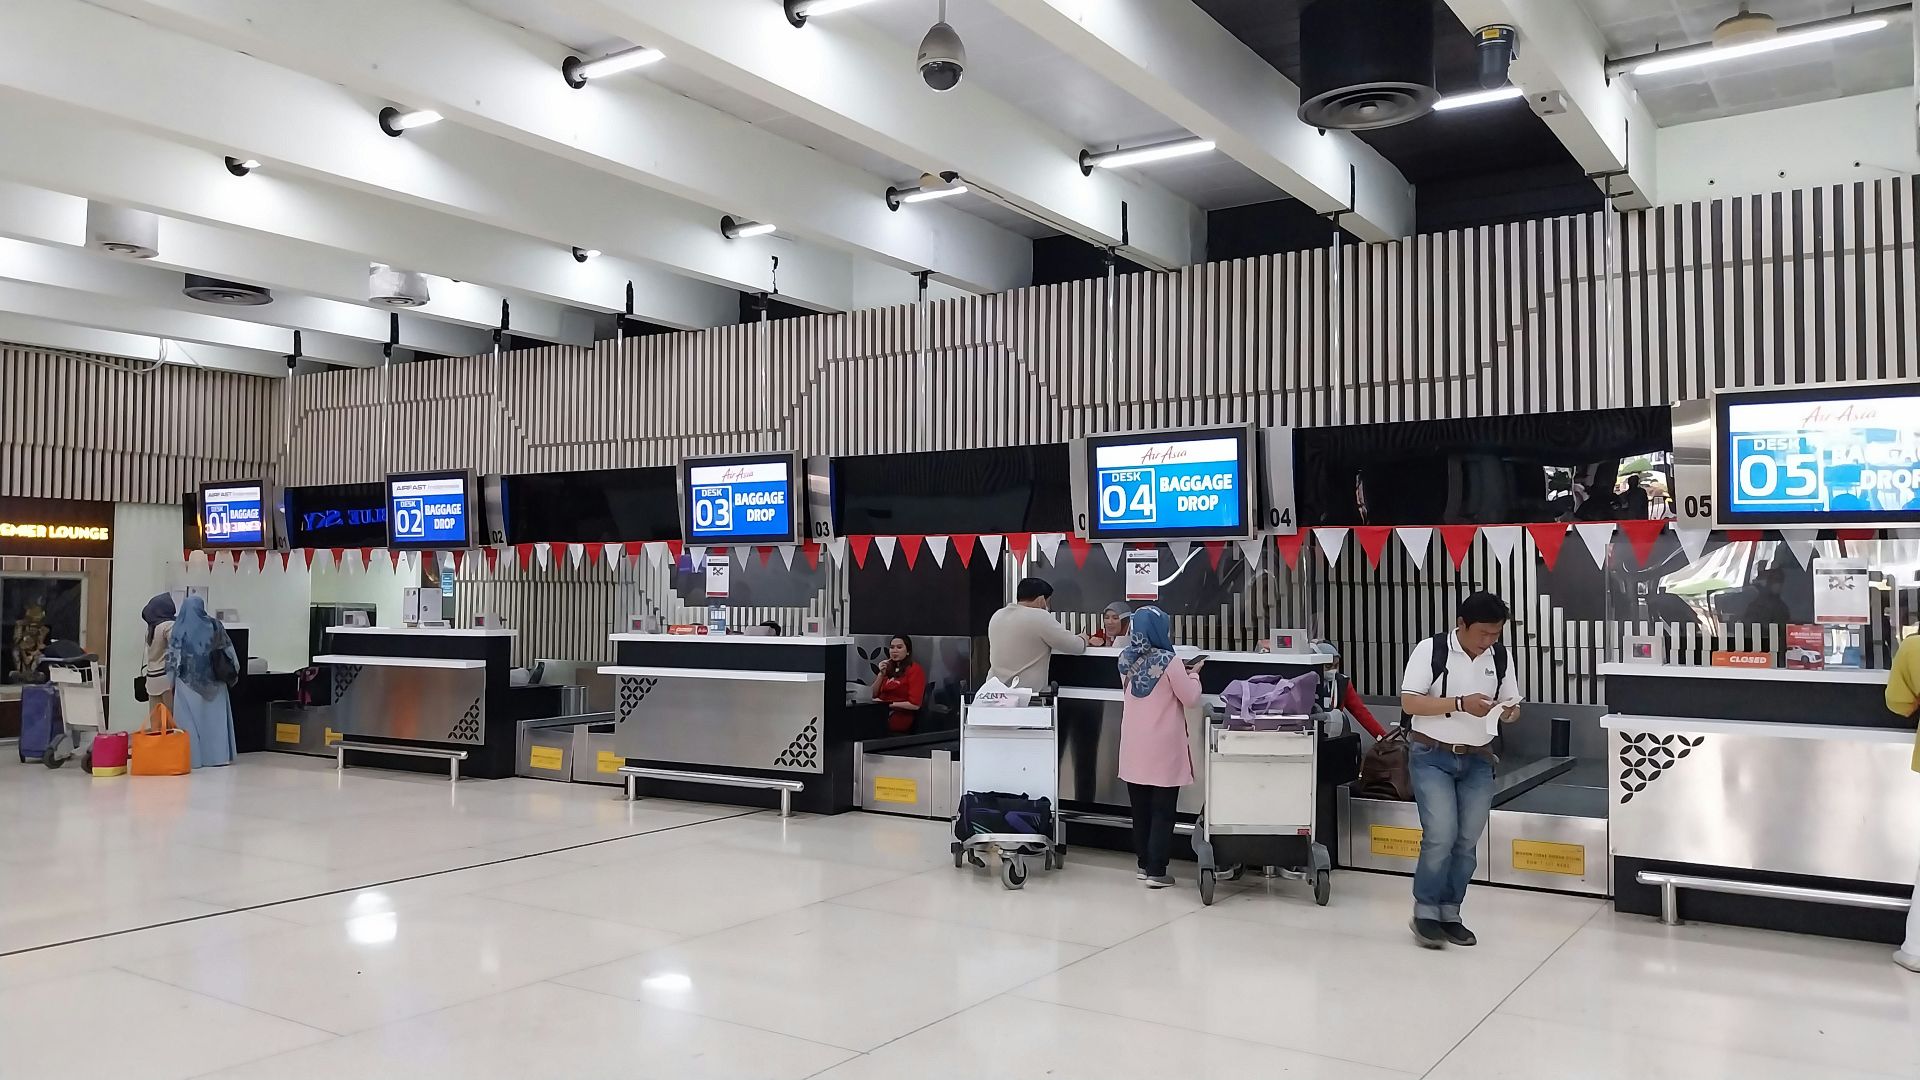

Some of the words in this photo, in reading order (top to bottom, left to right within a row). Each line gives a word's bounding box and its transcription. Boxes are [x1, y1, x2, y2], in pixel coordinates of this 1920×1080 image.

[1111, 471, 1141, 483] DESK
[1740, 453, 1817, 497] 05
[1159, 474, 1233, 493] BAGGAGE
[701, 488, 723, 497] DESK
[734, 491, 785, 506] BAGGAGE
[400, 500, 416, 508] DESK
[1103, 484, 1153, 518] 04
[1177, 495, 1219, 512] DROP
[1684, 495, 1712, 518] 05
[230, 508, 260, 519] BAGGAGE
[425, 504, 462, 516] BAGGAGE
[696, 498, 730, 526] 03
[746, 508, 776, 522] DROP
[1269, 507, 1292, 528] 04
[209, 512, 227, 534] 01
[397, 509, 422, 533] 02
[433, 518, 456, 530] DROP
[0, 523, 47, 538] EMIER
[48, 525, 109, 540] LOUNGE
[815, 521, 830, 537] 03
[279, 536, 287, 548] 01
[492, 530, 504, 544] 02
[1729, 655, 1767, 664] CLOSED
